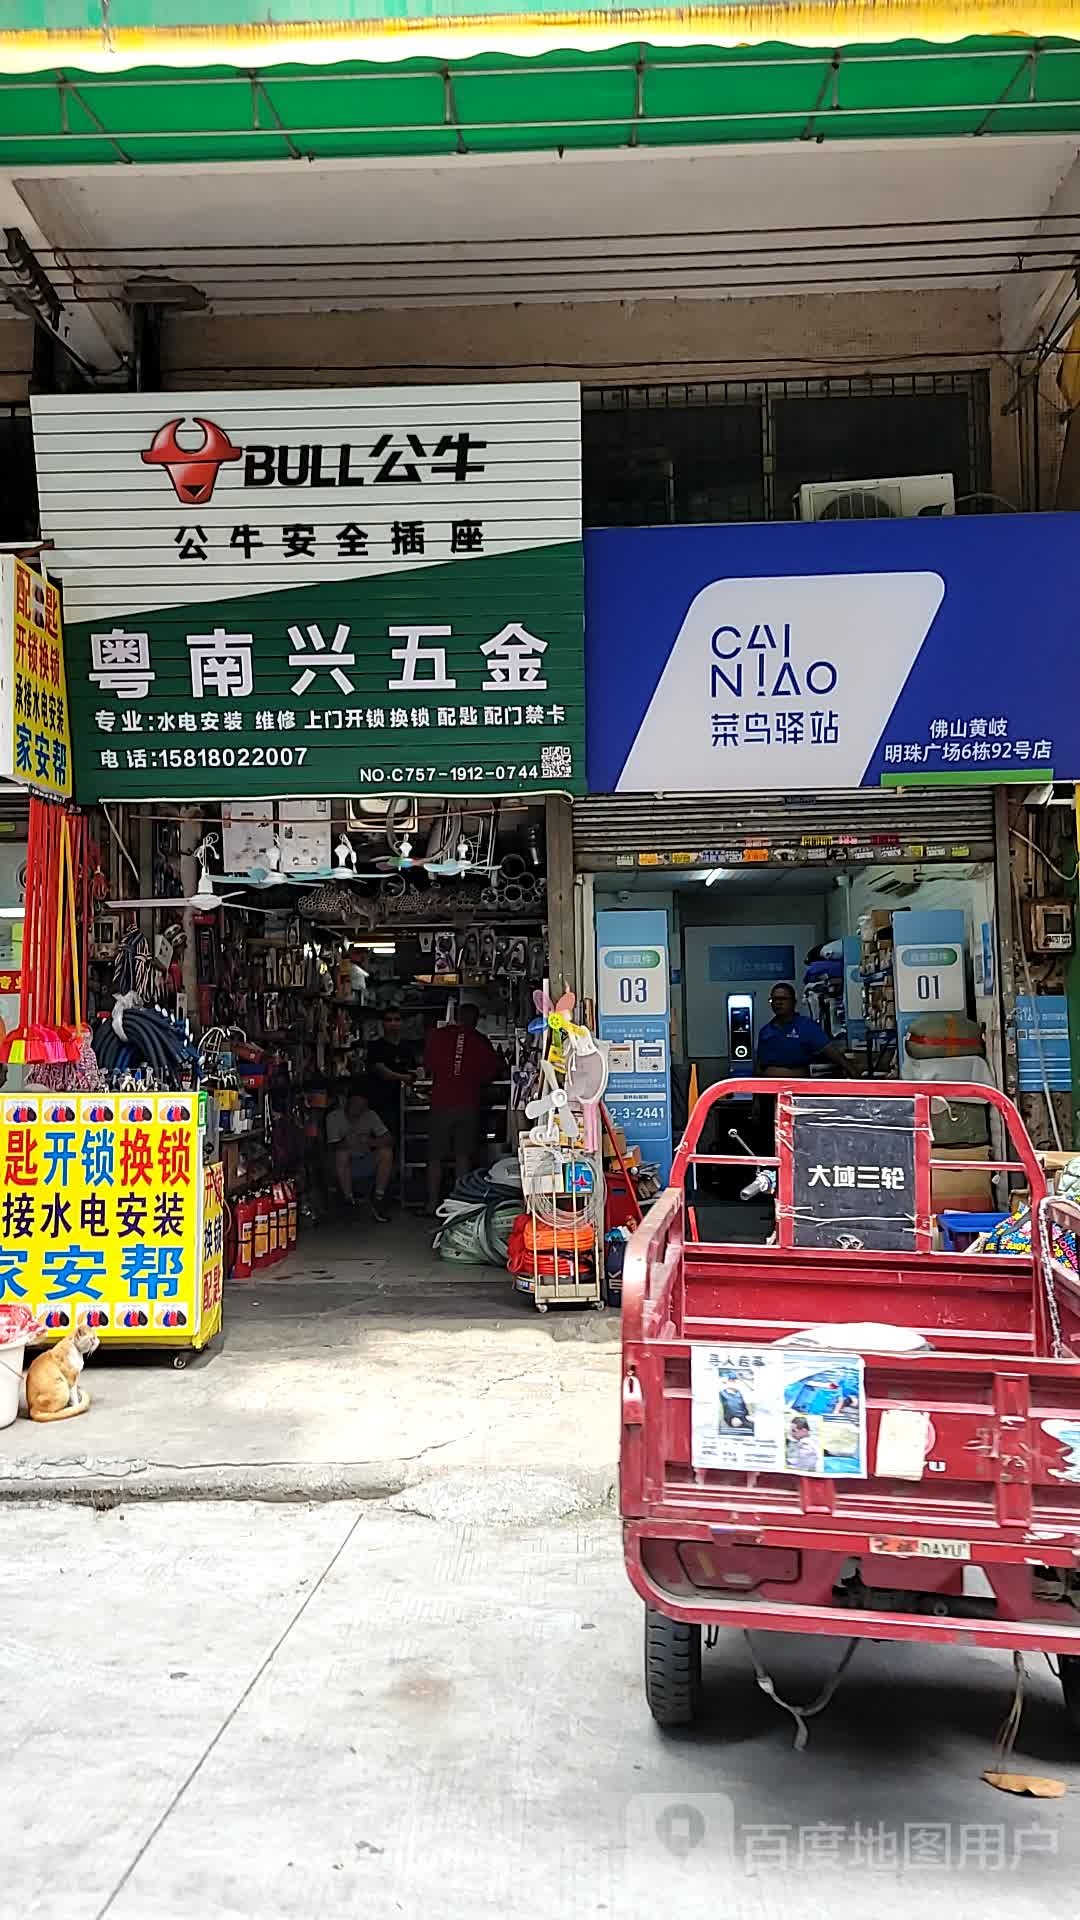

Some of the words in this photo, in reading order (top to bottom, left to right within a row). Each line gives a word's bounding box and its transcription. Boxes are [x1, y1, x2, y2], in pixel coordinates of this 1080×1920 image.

[244, 443, 364, 488] BULL
[368, 431, 487, 484] 公牛
[174, 519, 485, 561] 公牛安全插座
[15, 622, 61, 688] 开锁换锁
[89, 622, 549, 700] 粤南兴五金
[15, 672, 65, 736] 承接水电安装
[255, 711, 296, 731] 维修
[437, 706, 478, 727] 配匙
[484, 704, 566, 726] 配门禁卡
[711, 710, 839, 746] 菜鸟驿站
[929, 718, 1008, 738] 佛山黄岐
[16, 722, 67, 787] 家安帮
[884, 741, 1053, 762] 明珠广场6栋92号店
[619, 977, 648, 1003] 03
[917, 975, 940, 999] 01
[4, 1128, 190, 1187] 匙开锁换锁
[807, 1164, 905, 1190] 大域三轮
[3, 1192, 184, 1238] 接水电安装
[0, 1243, 184, 1300] 家安帮
